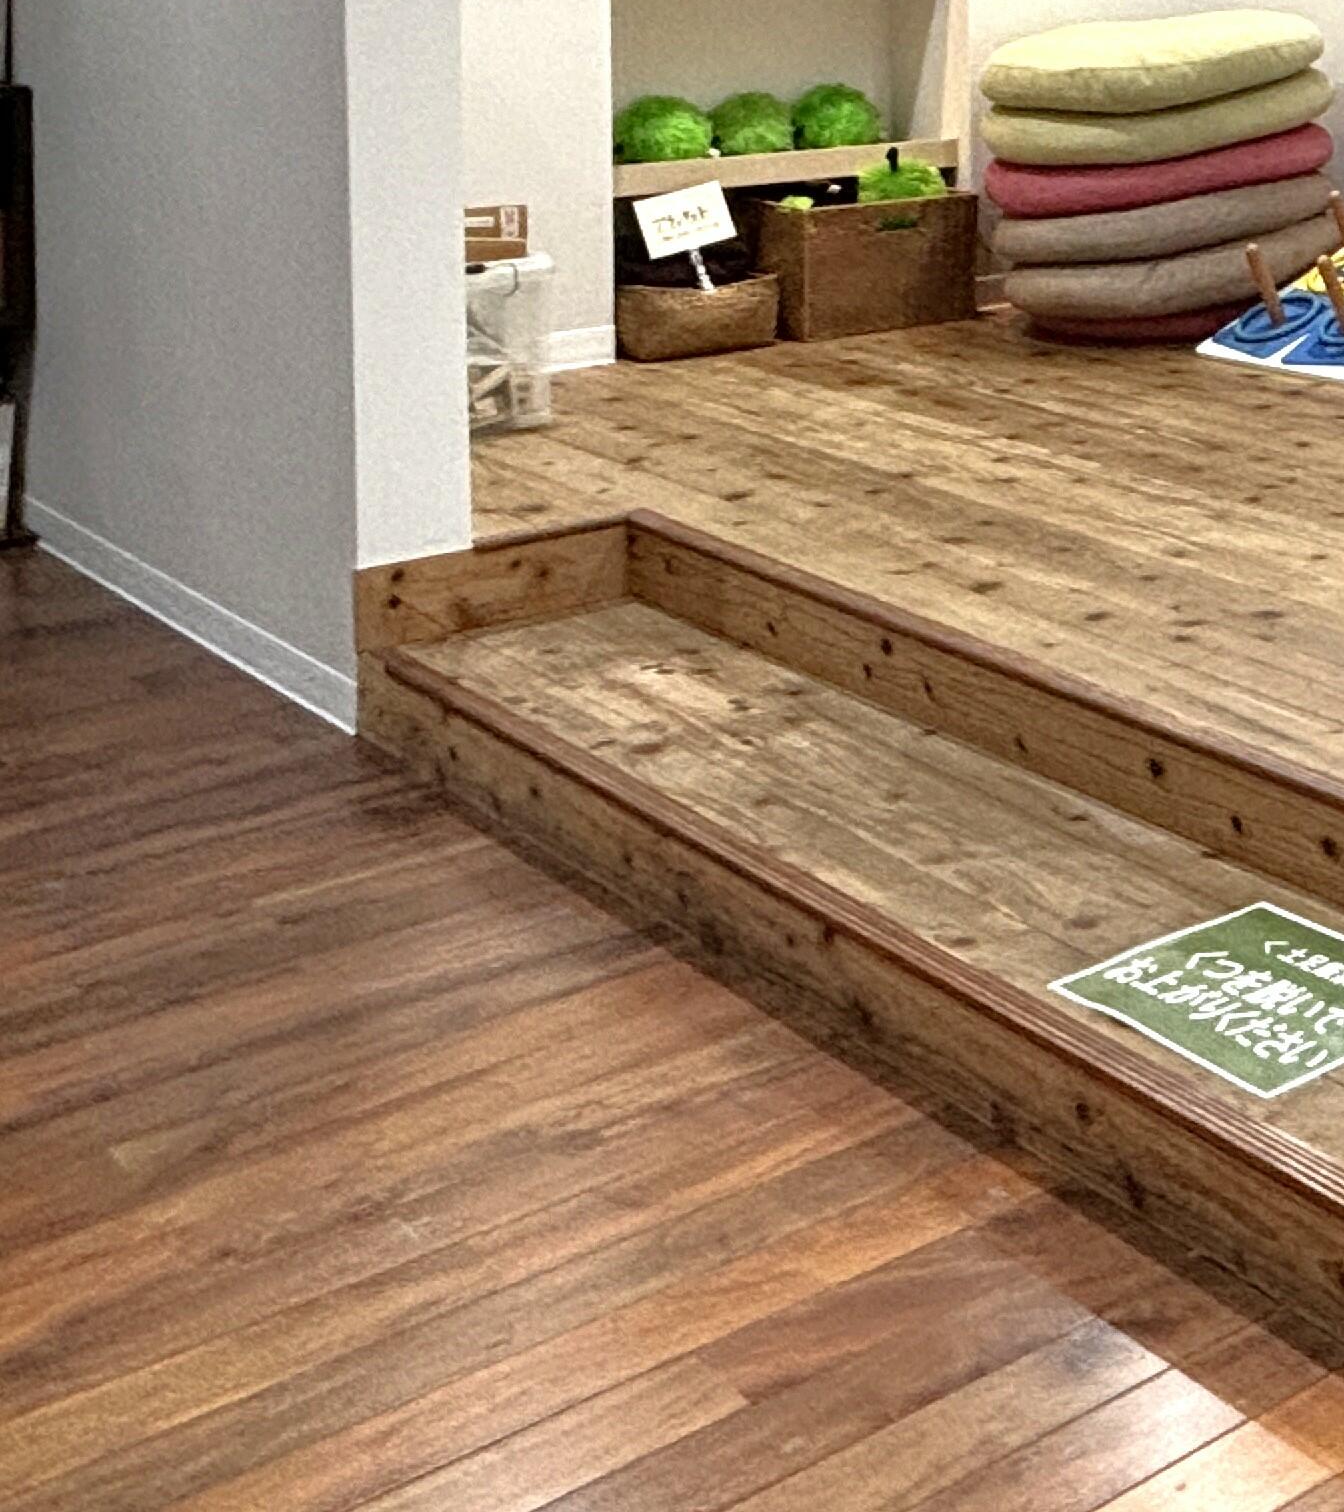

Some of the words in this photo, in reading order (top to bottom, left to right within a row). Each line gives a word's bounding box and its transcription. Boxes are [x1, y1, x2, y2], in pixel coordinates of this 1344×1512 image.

[1103, 956, 1328, 1067] お上がりください
